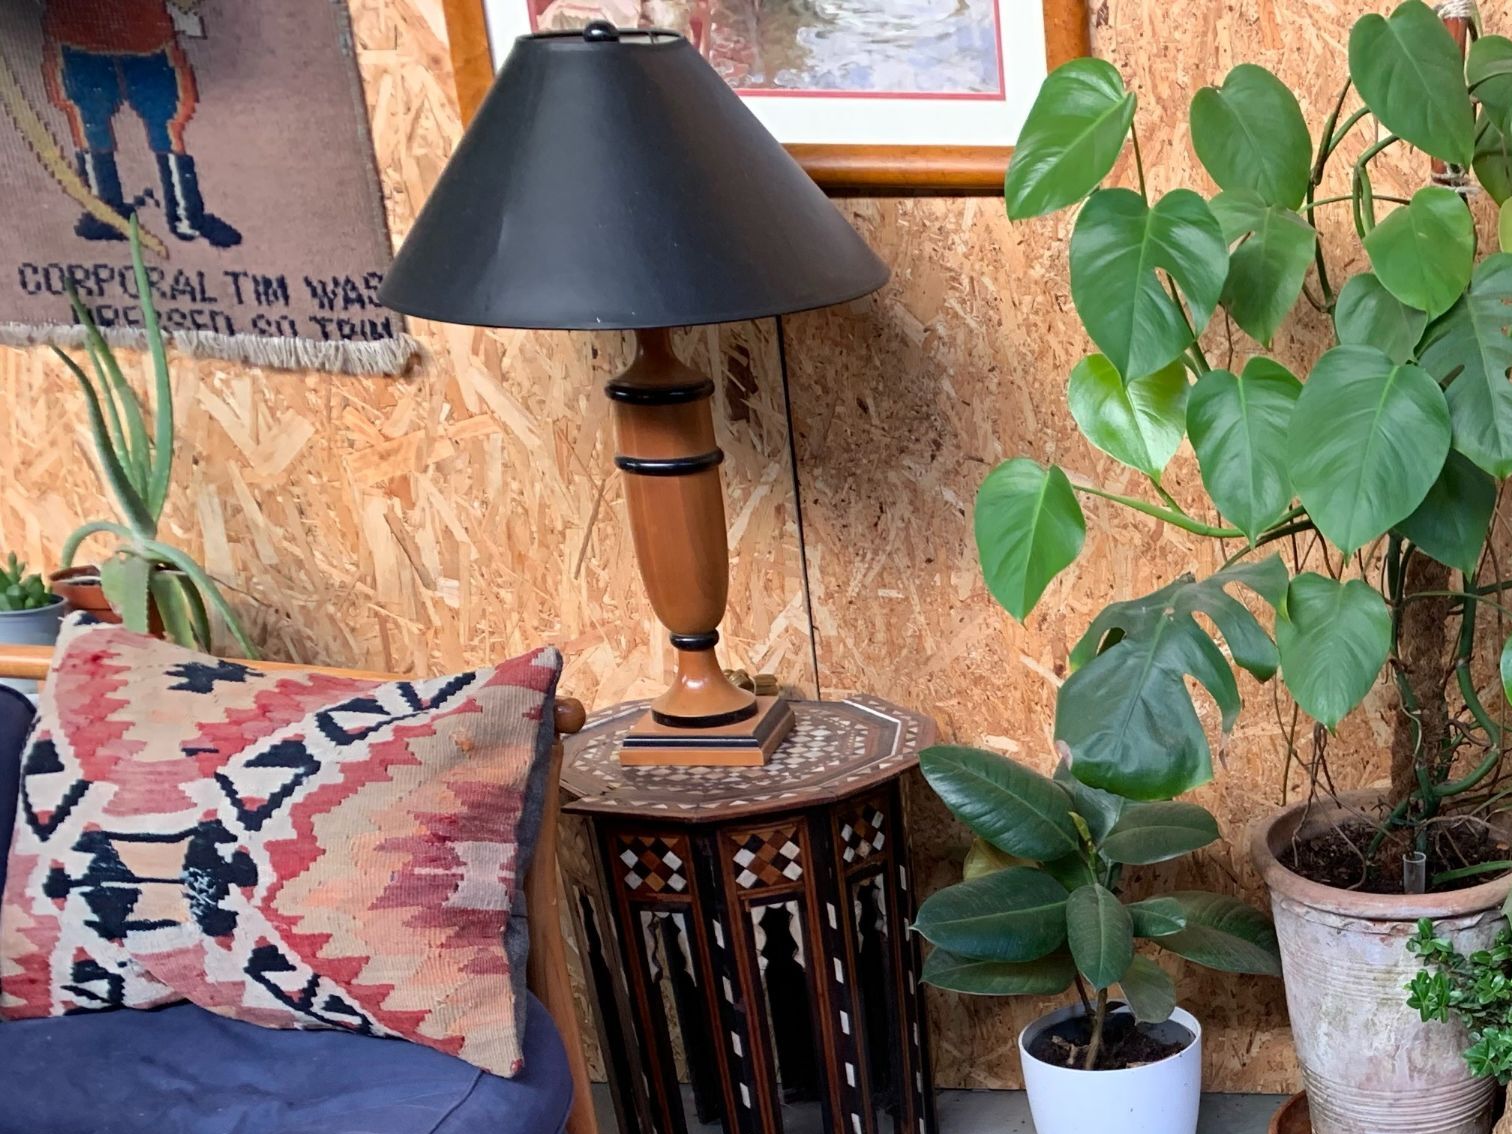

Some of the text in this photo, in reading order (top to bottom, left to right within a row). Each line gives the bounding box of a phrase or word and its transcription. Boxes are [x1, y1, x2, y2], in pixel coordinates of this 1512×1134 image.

[18, 262, 384, 312] CORPORAL TIM WAS
